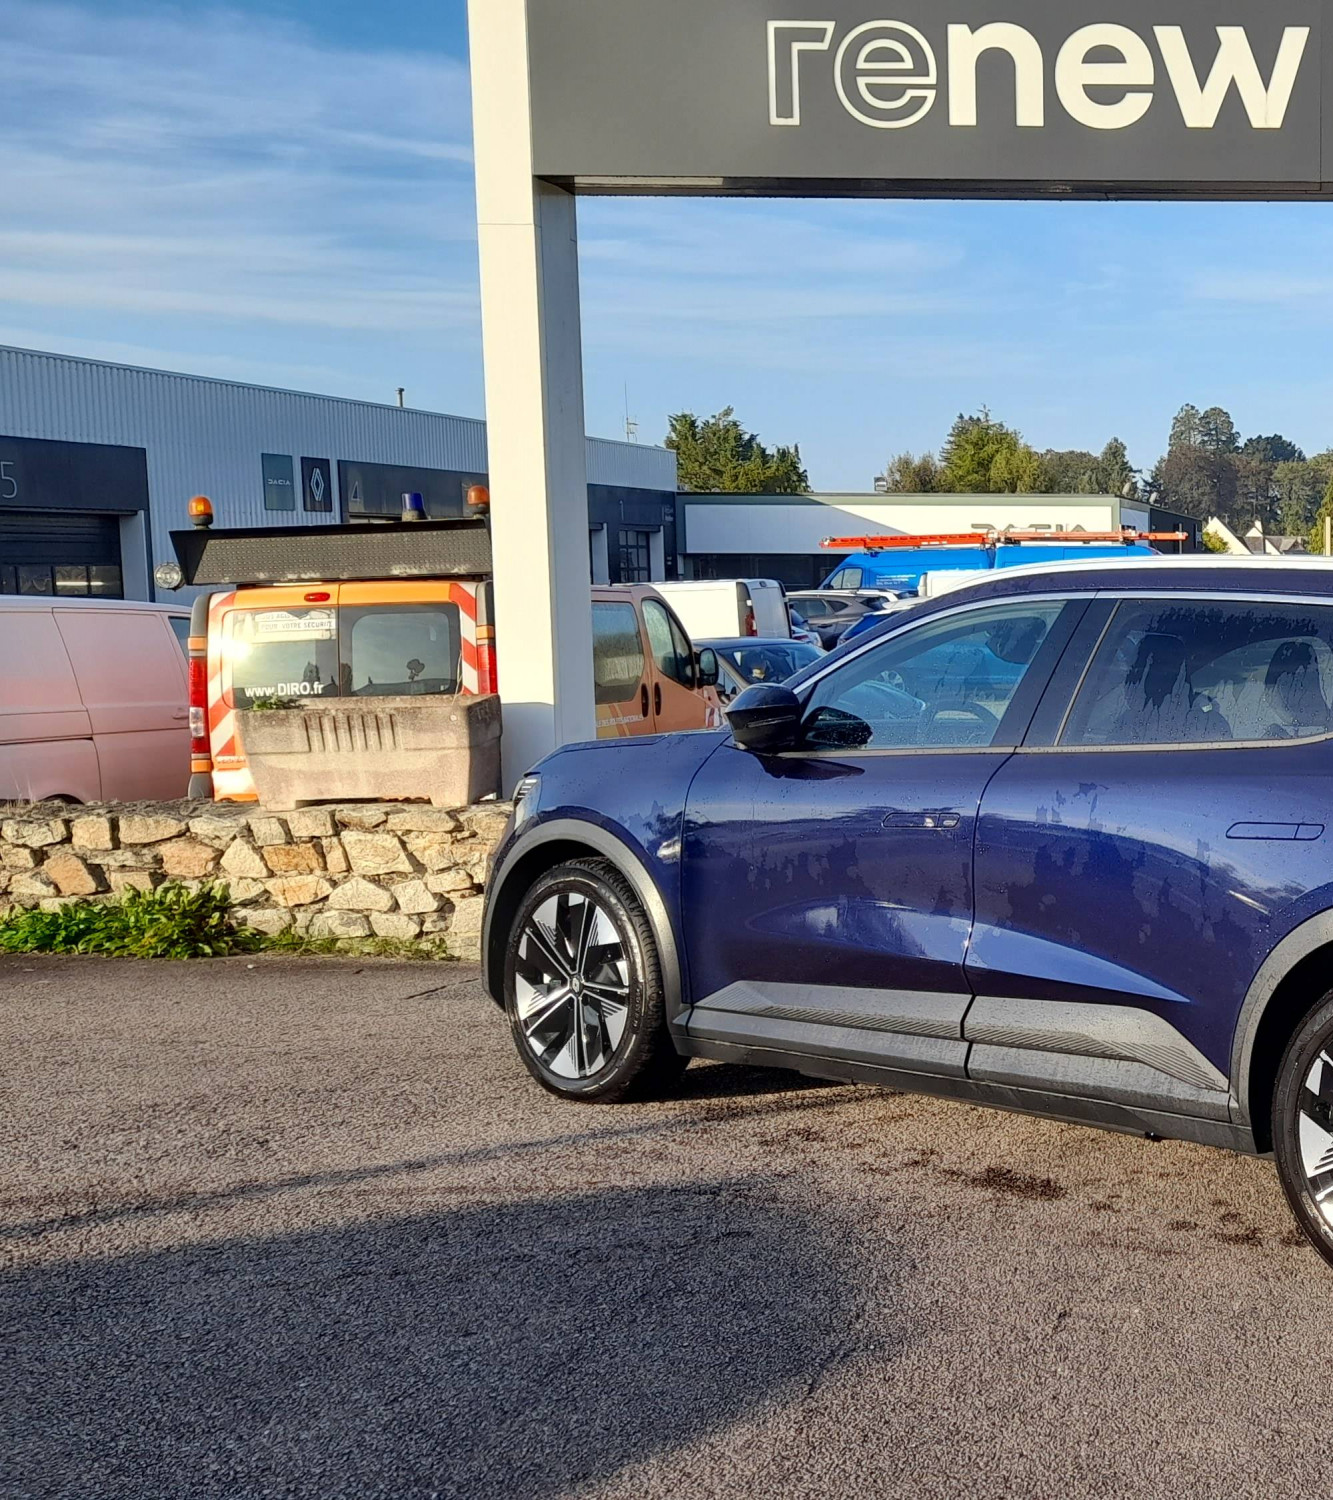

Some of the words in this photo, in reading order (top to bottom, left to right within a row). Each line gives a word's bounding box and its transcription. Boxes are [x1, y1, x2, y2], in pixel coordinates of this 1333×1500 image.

[766, 19, 1310, 129] renew
[0, 461, 17, 498] 5
[267, 478, 291, 486] DACIA
[351, 480, 363, 500] 4
[281, 622, 302, 630] VOTRE
[244, 681, 325, 697] www.DIRO.fr
